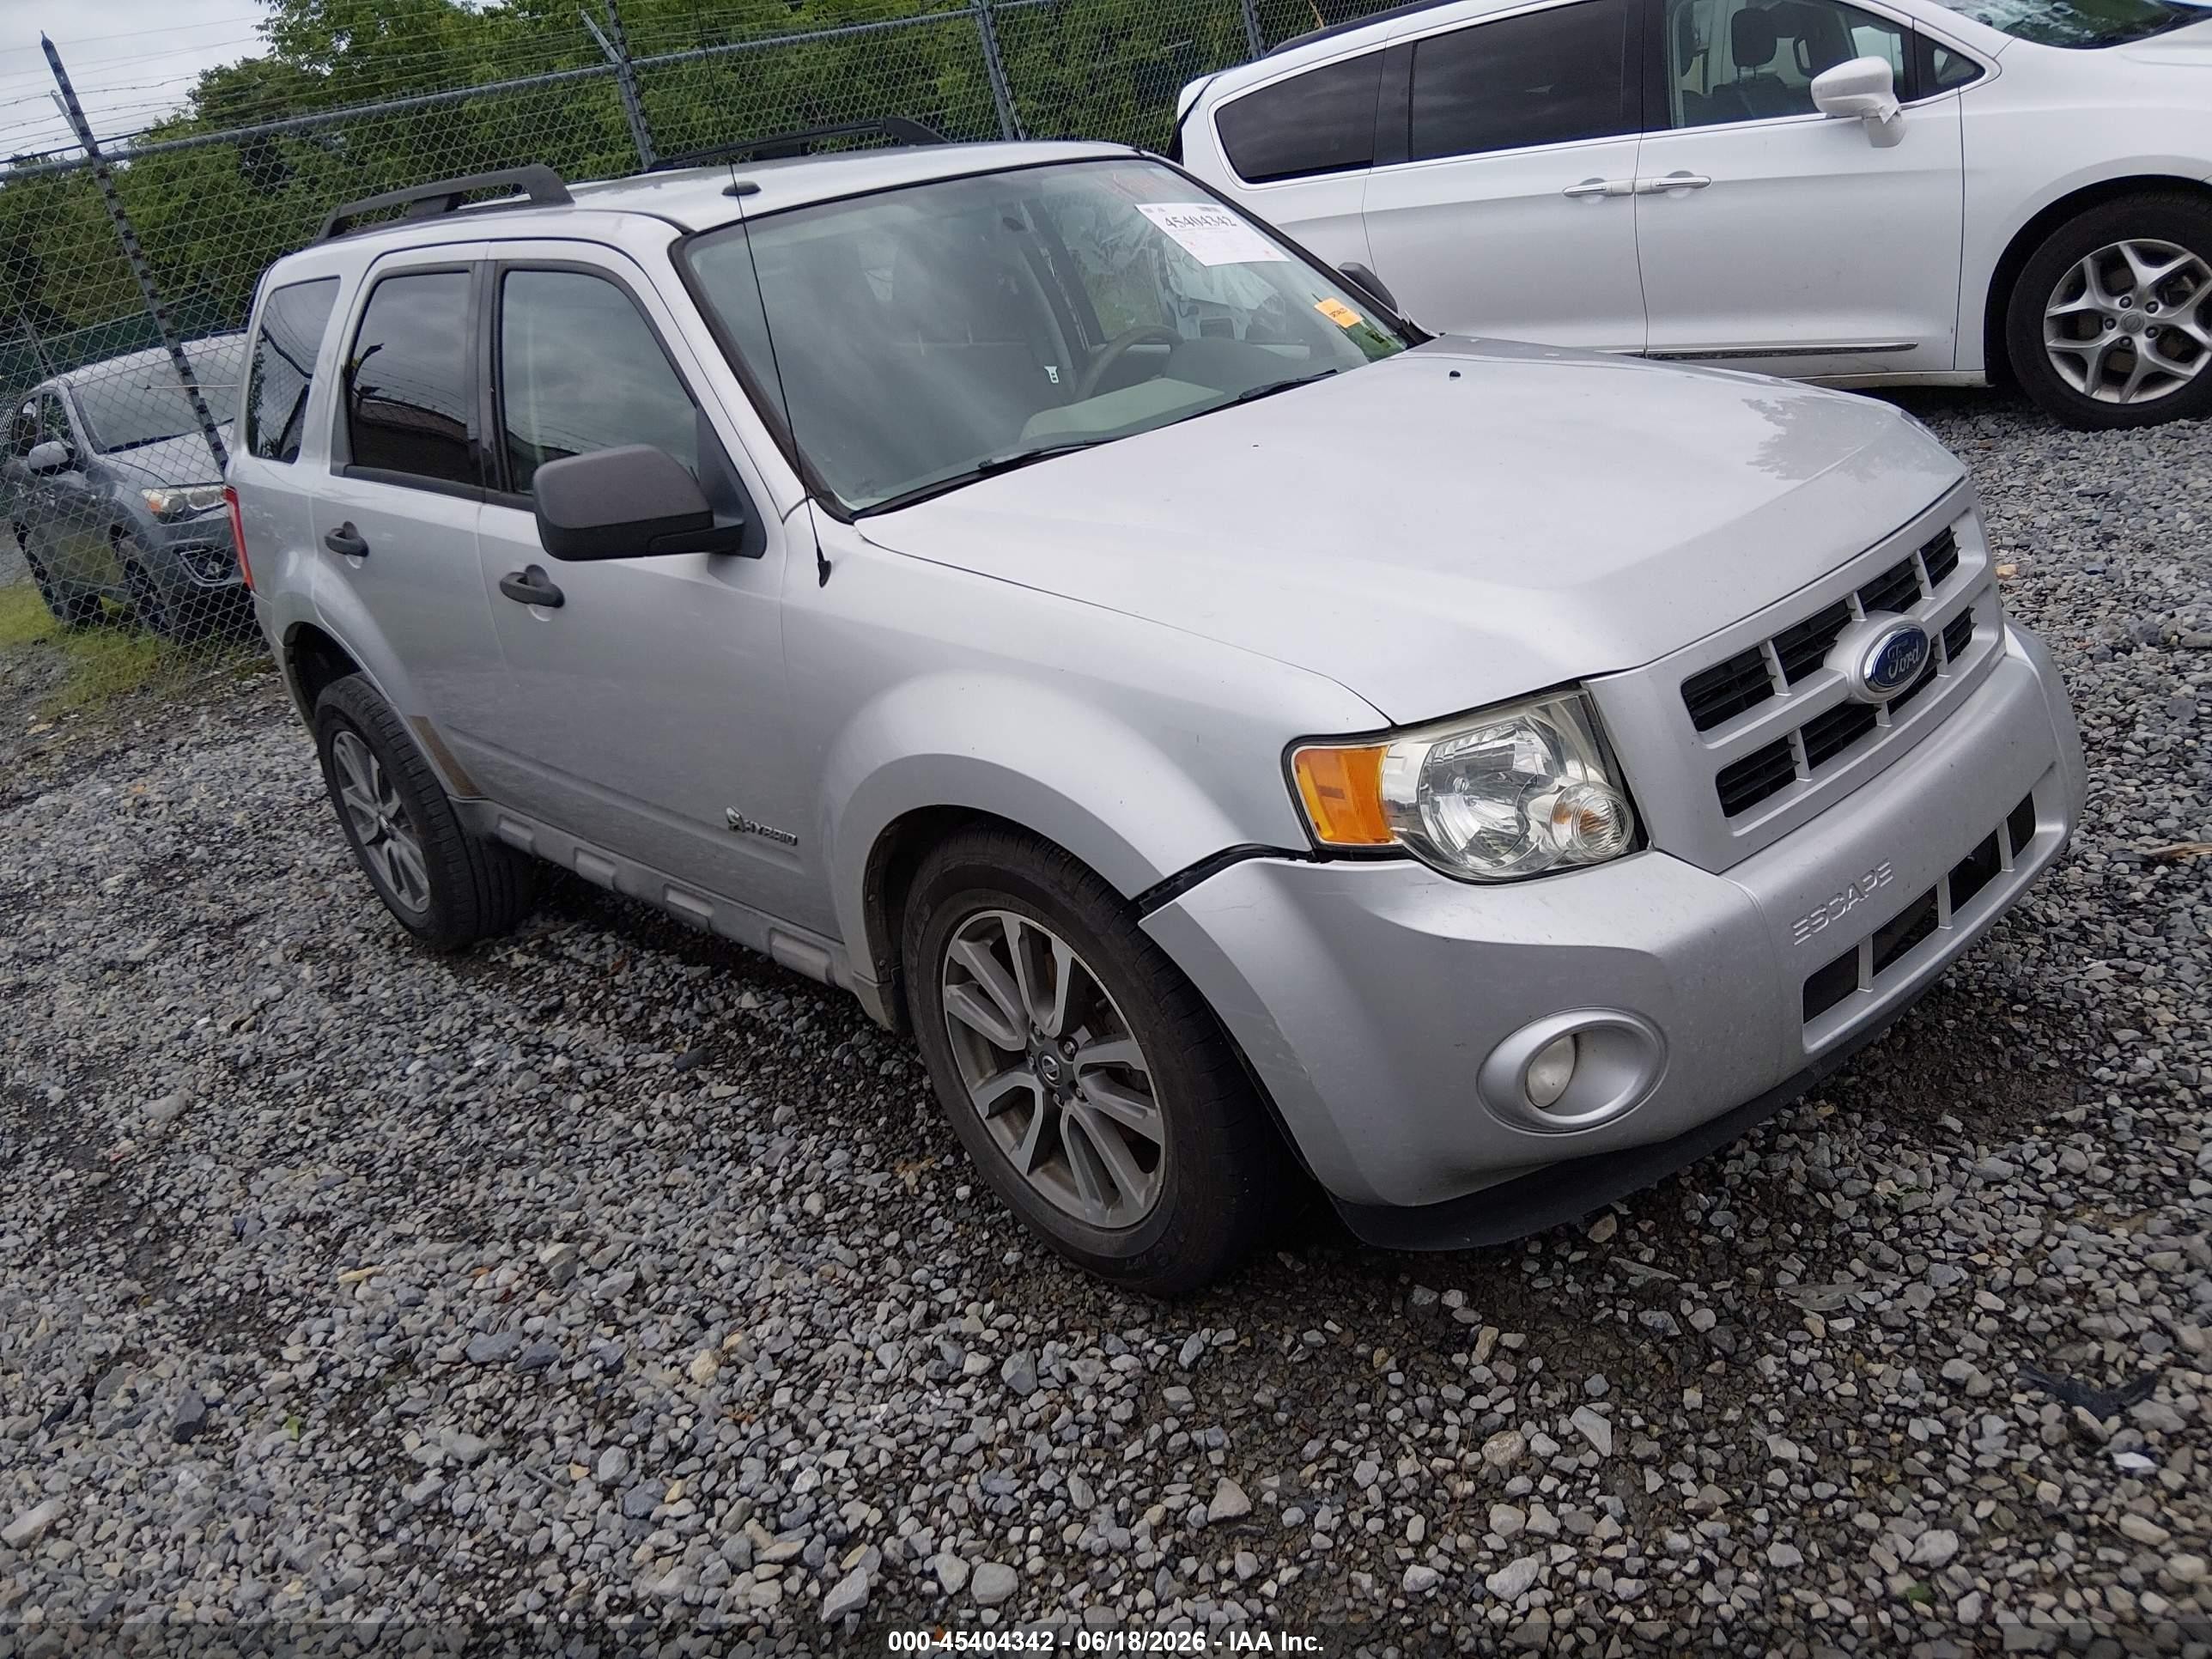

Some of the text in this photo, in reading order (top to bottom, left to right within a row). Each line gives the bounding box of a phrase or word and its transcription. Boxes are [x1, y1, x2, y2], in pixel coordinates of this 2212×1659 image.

[1164, 216, 1237, 228] 45404342
[1887, 637, 1922, 679] Ford
[1790, 858, 1894, 946] ESCAPE
